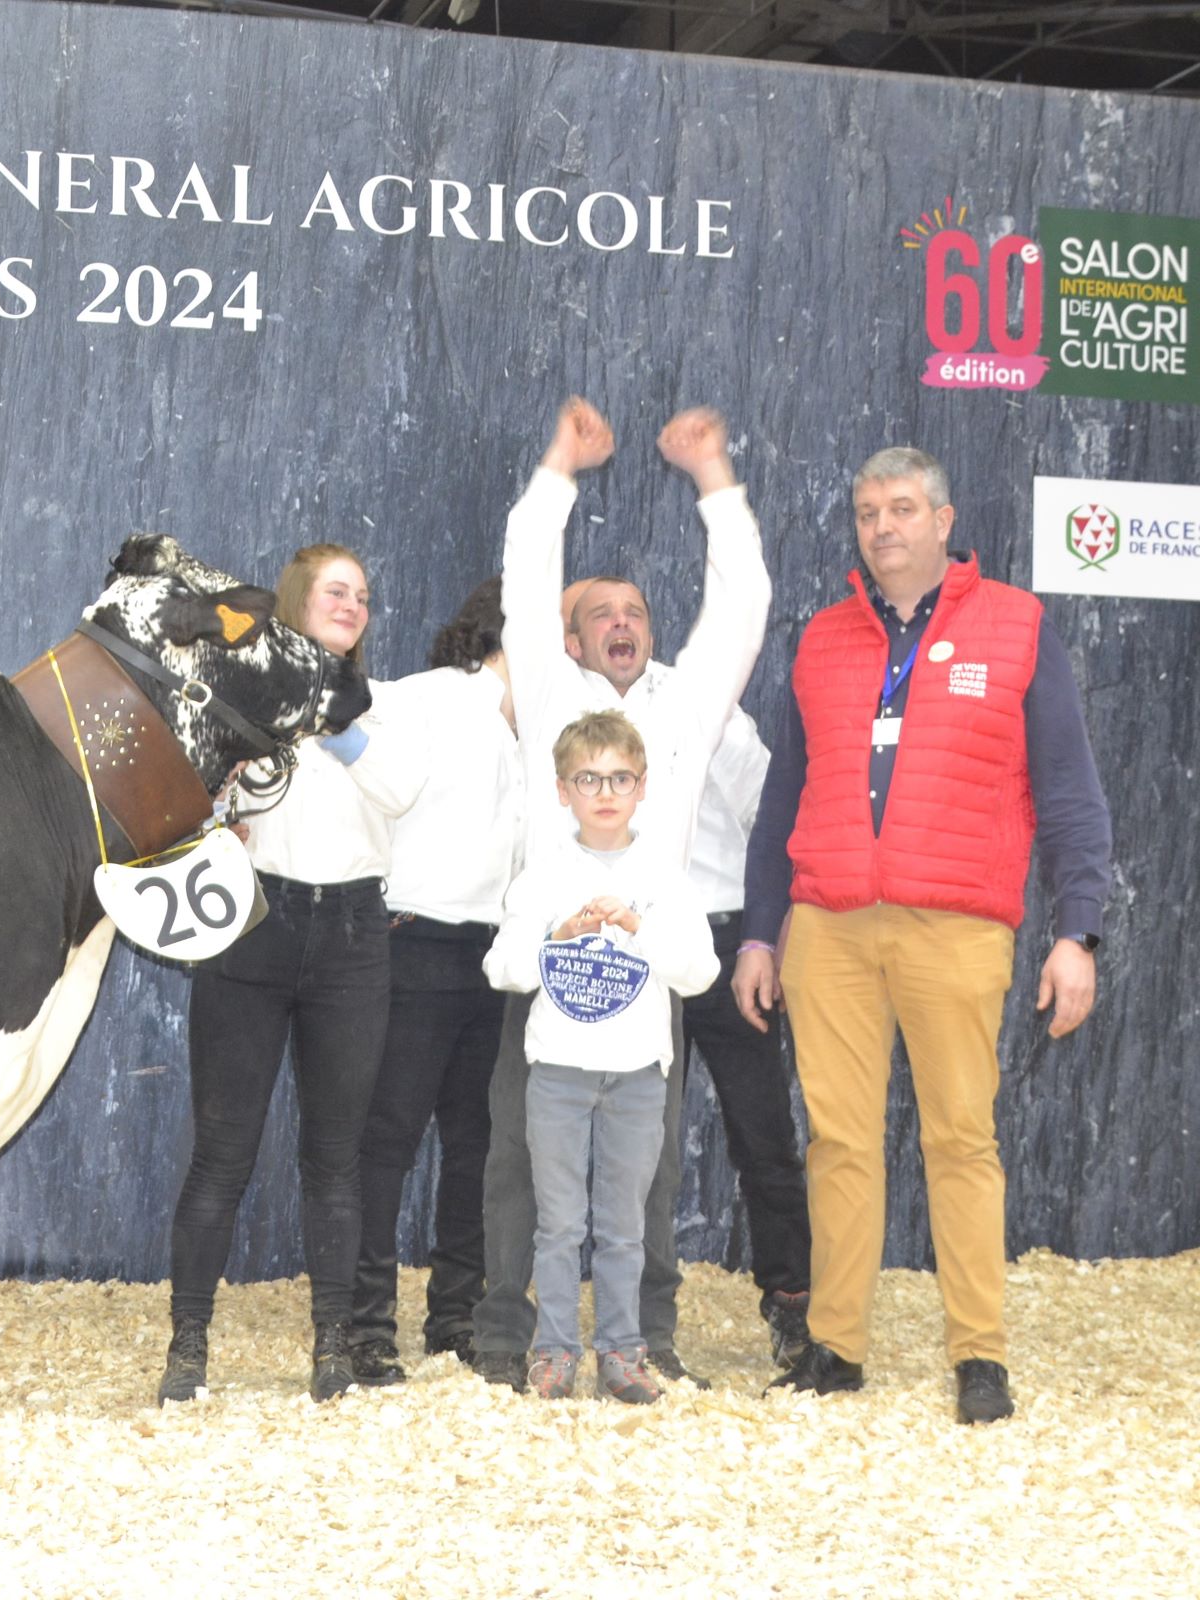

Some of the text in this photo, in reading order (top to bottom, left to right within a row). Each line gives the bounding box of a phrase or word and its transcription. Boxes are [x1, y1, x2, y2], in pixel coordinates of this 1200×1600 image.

[300, 170, 734, 259] AGRICOLE
[1060, 237, 1188, 283] SALON
[76, 262, 263, 332] 2024
[1059, 277, 1187, 304] INTERNATIONAL
[1060, 339, 1187, 375] CULTURE
[939, 357, 1025, 385] édition
[1129, 518, 1200, 541] RACE
[1129, 541, 1148, 555] DE
[134, 858, 237, 948] 26
[555, 957, 629, 981] PARIS 2024
[591, 978, 633, 994] BOVINE
[563, 991, 611, 1009] MAMELLE
